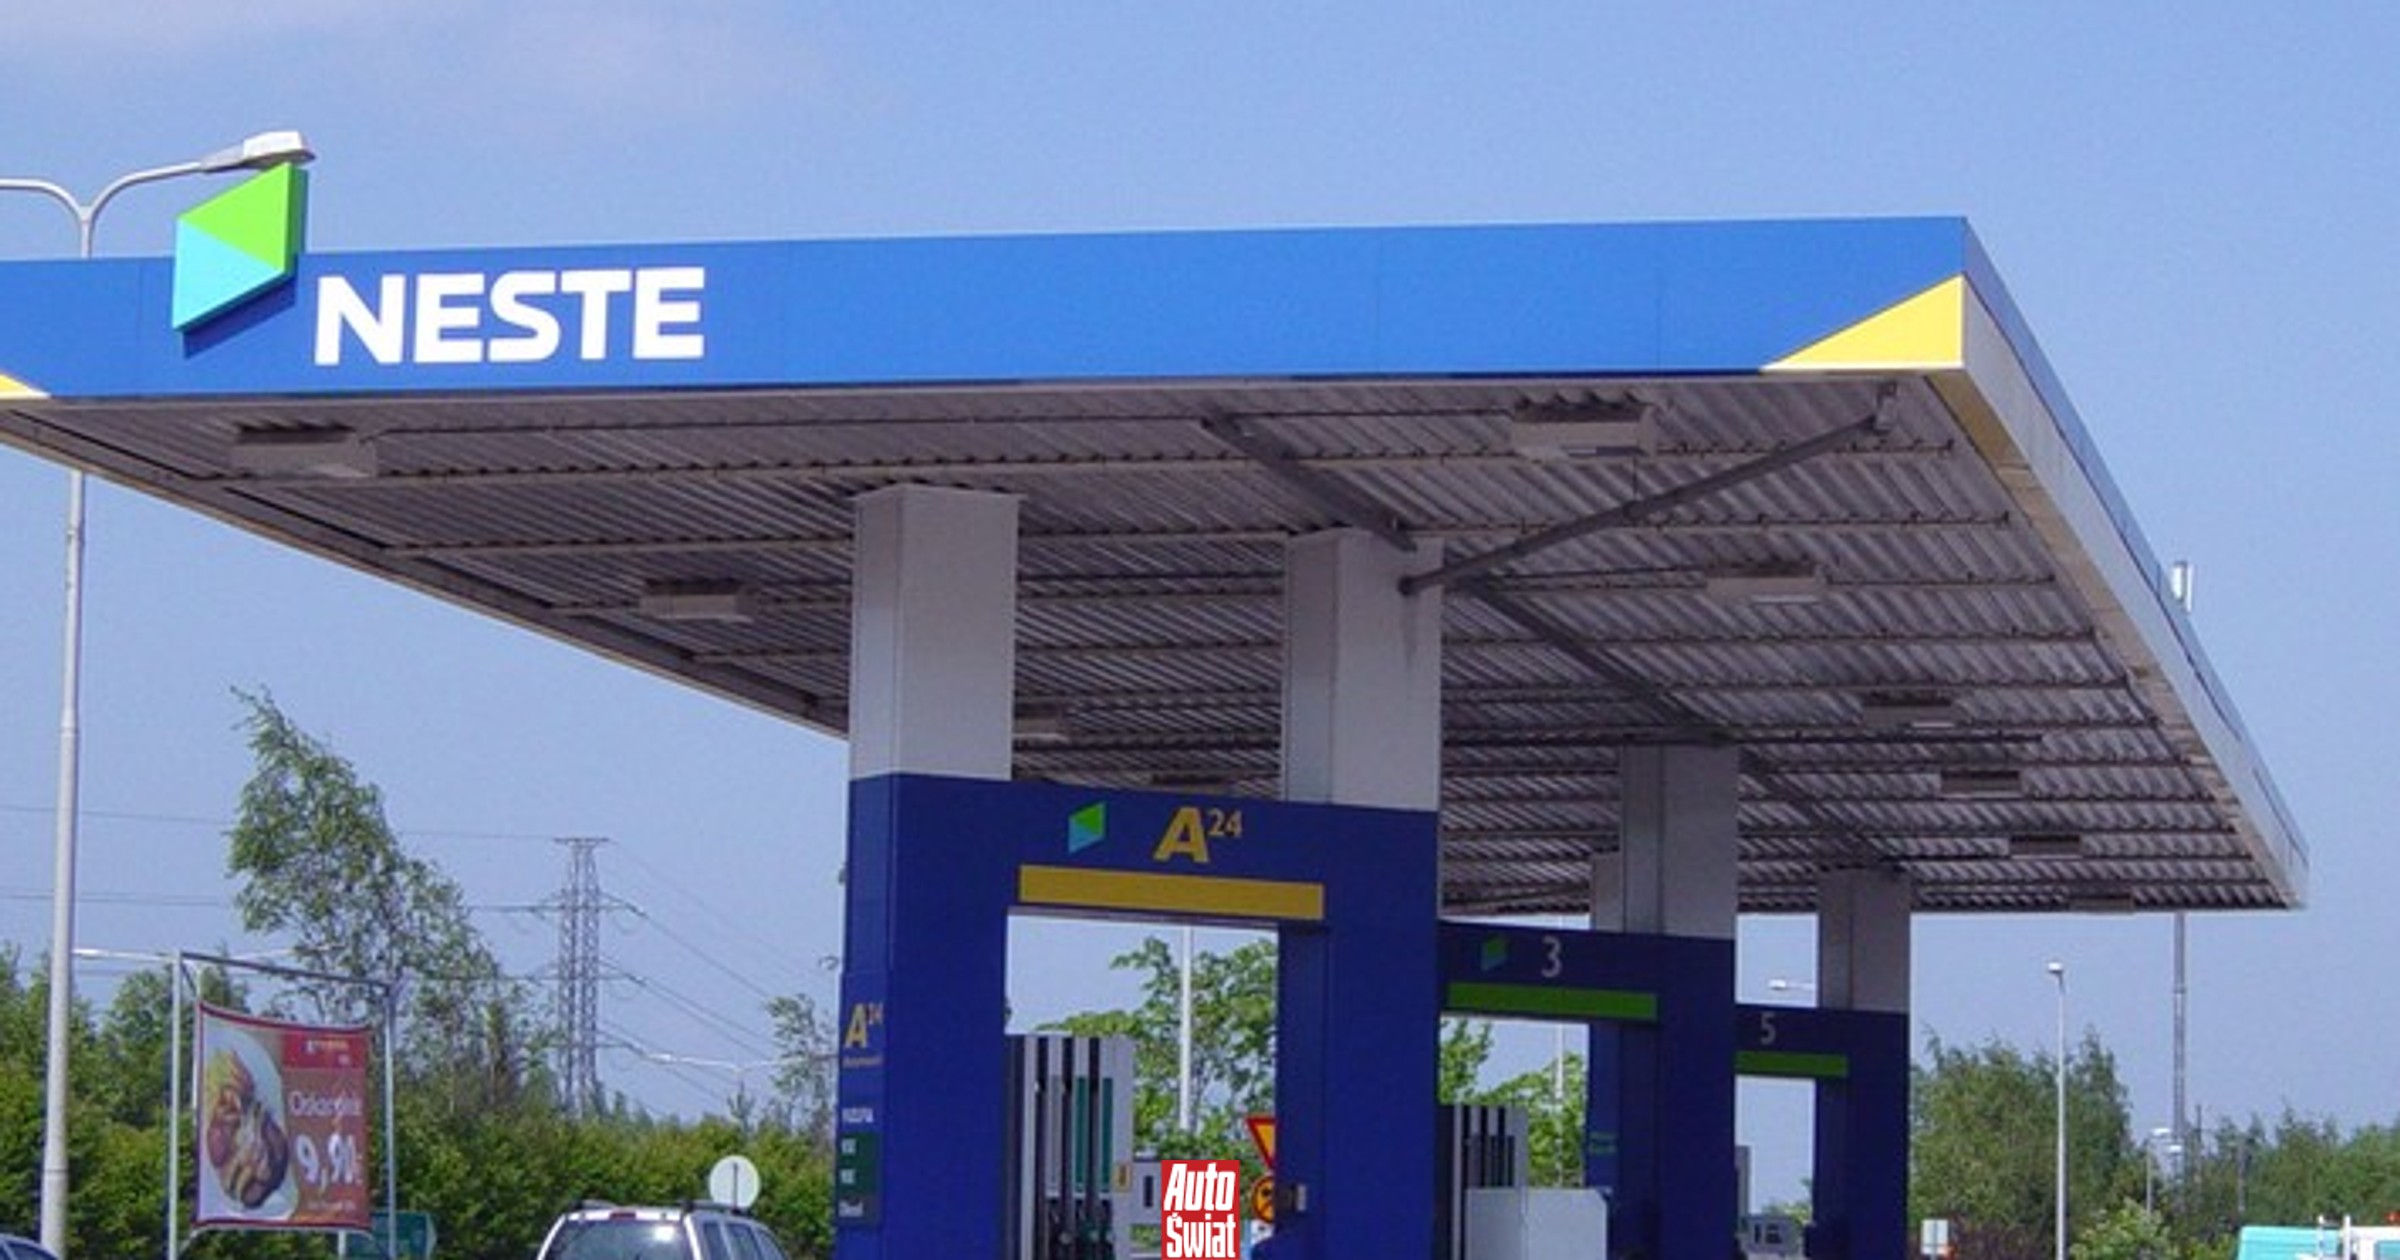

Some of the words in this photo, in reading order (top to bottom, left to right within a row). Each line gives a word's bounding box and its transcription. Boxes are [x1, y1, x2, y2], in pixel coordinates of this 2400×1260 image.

[314, 267, 705, 366] NESTE
[1541, 935, 1562, 978] 3
[1760, 1011, 1776, 1045] 5
